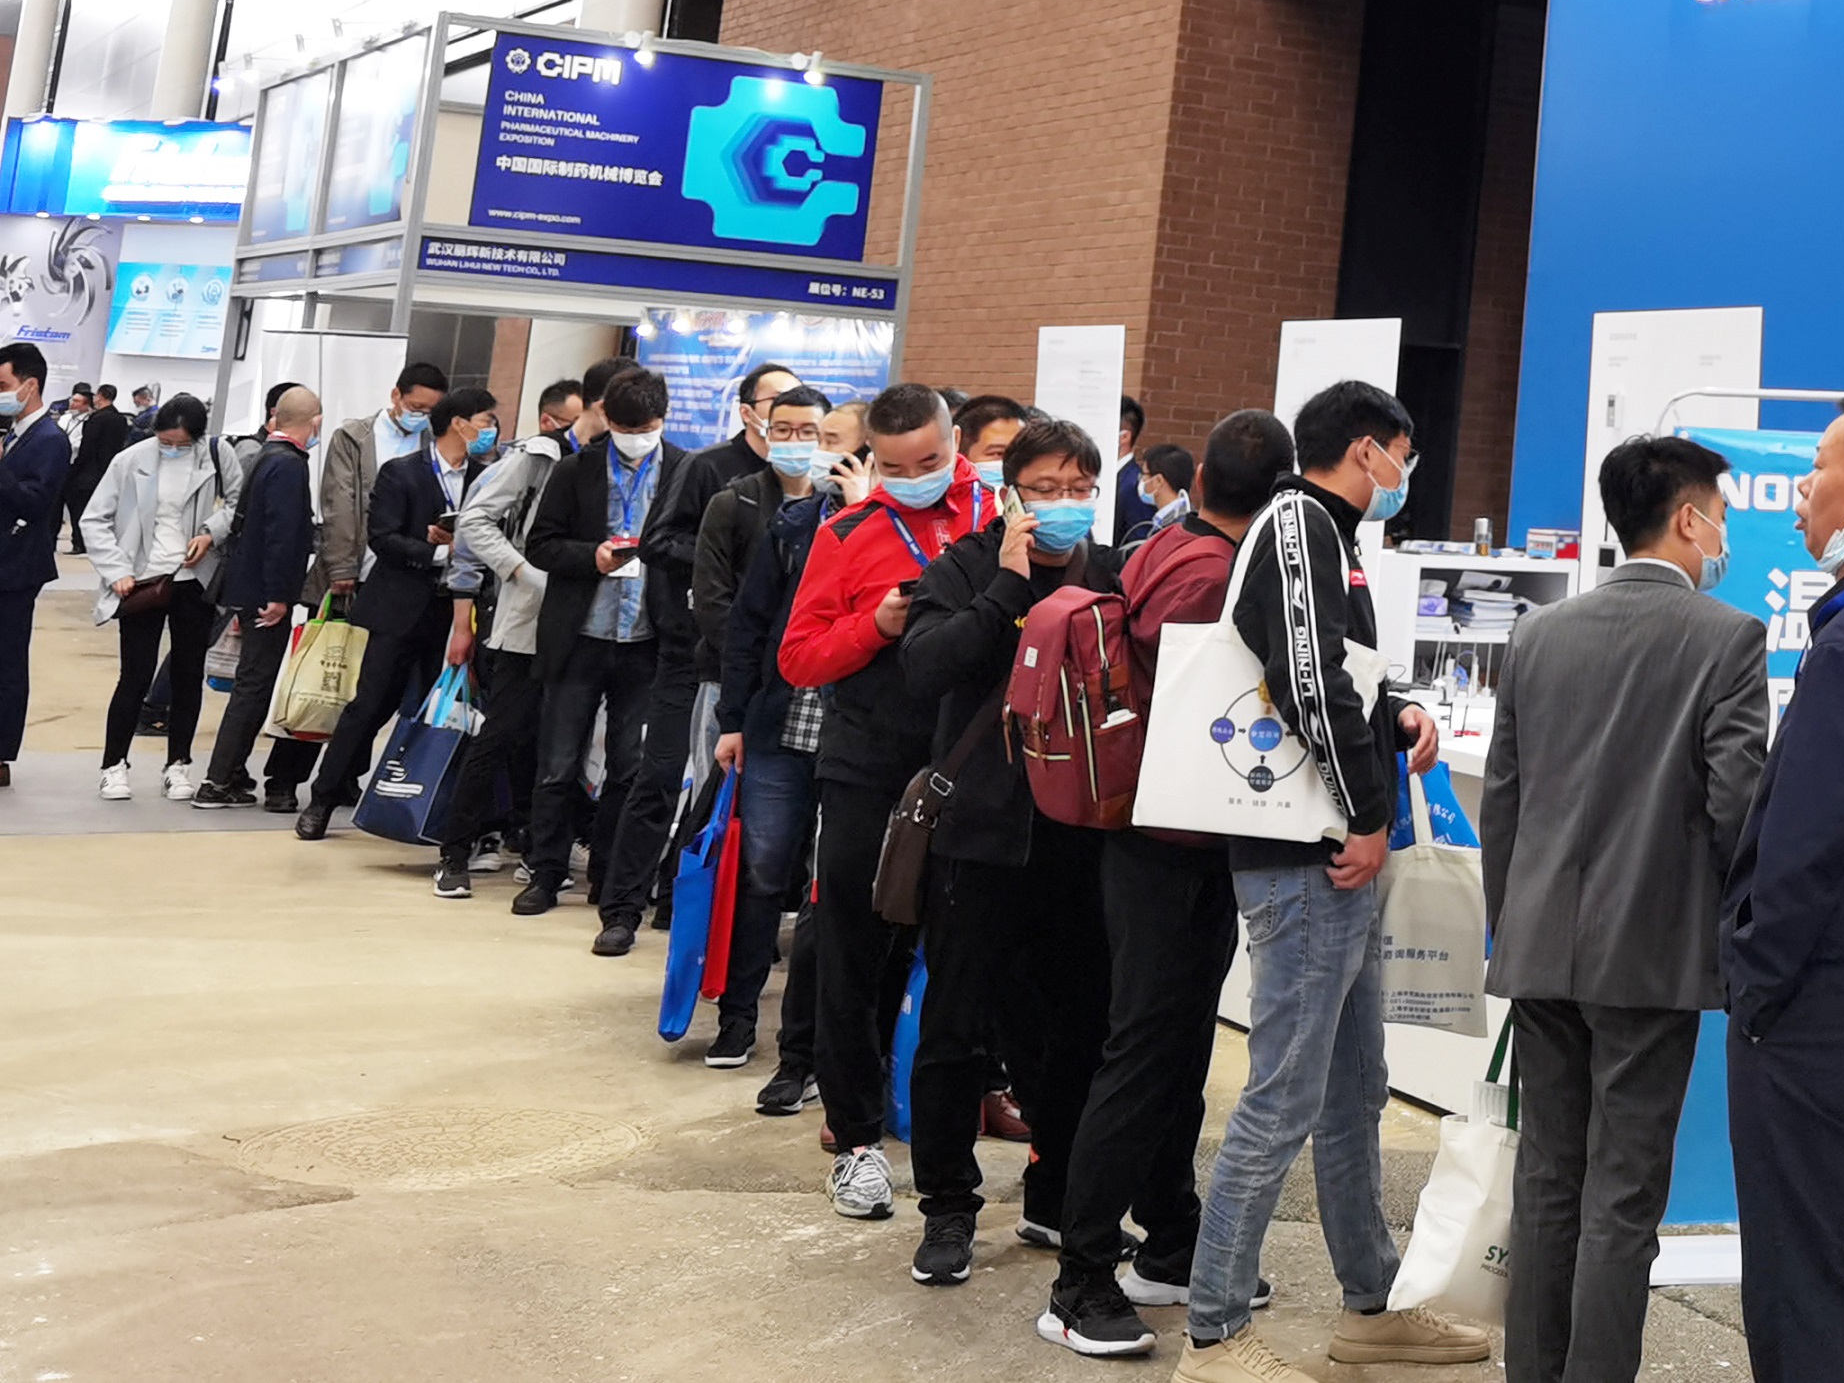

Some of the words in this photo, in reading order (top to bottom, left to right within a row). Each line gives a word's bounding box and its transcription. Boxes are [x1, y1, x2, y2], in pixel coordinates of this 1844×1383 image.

[536, 51, 623, 85] CIPM
[504, 89, 545, 105] CHINA
[502, 104, 600, 125] INTERNATIONAL
[499, 132, 555, 147] EXPOSITION
[500, 120, 584, 139] PHARMACEUTICAL
[585, 130, 640, 144] MACHINERY
[495, 154, 664, 187] 中国国际制药机械博览会
[481, 263, 501, 272] NEW
[502, 264, 525, 274] TECH
[852, 286, 885, 300] NE-53
[1717, 473, 1803, 511] NO
[1295, 626, 1314, 697] LI-NING
[1484, 1245, 1509, 1267] SY
